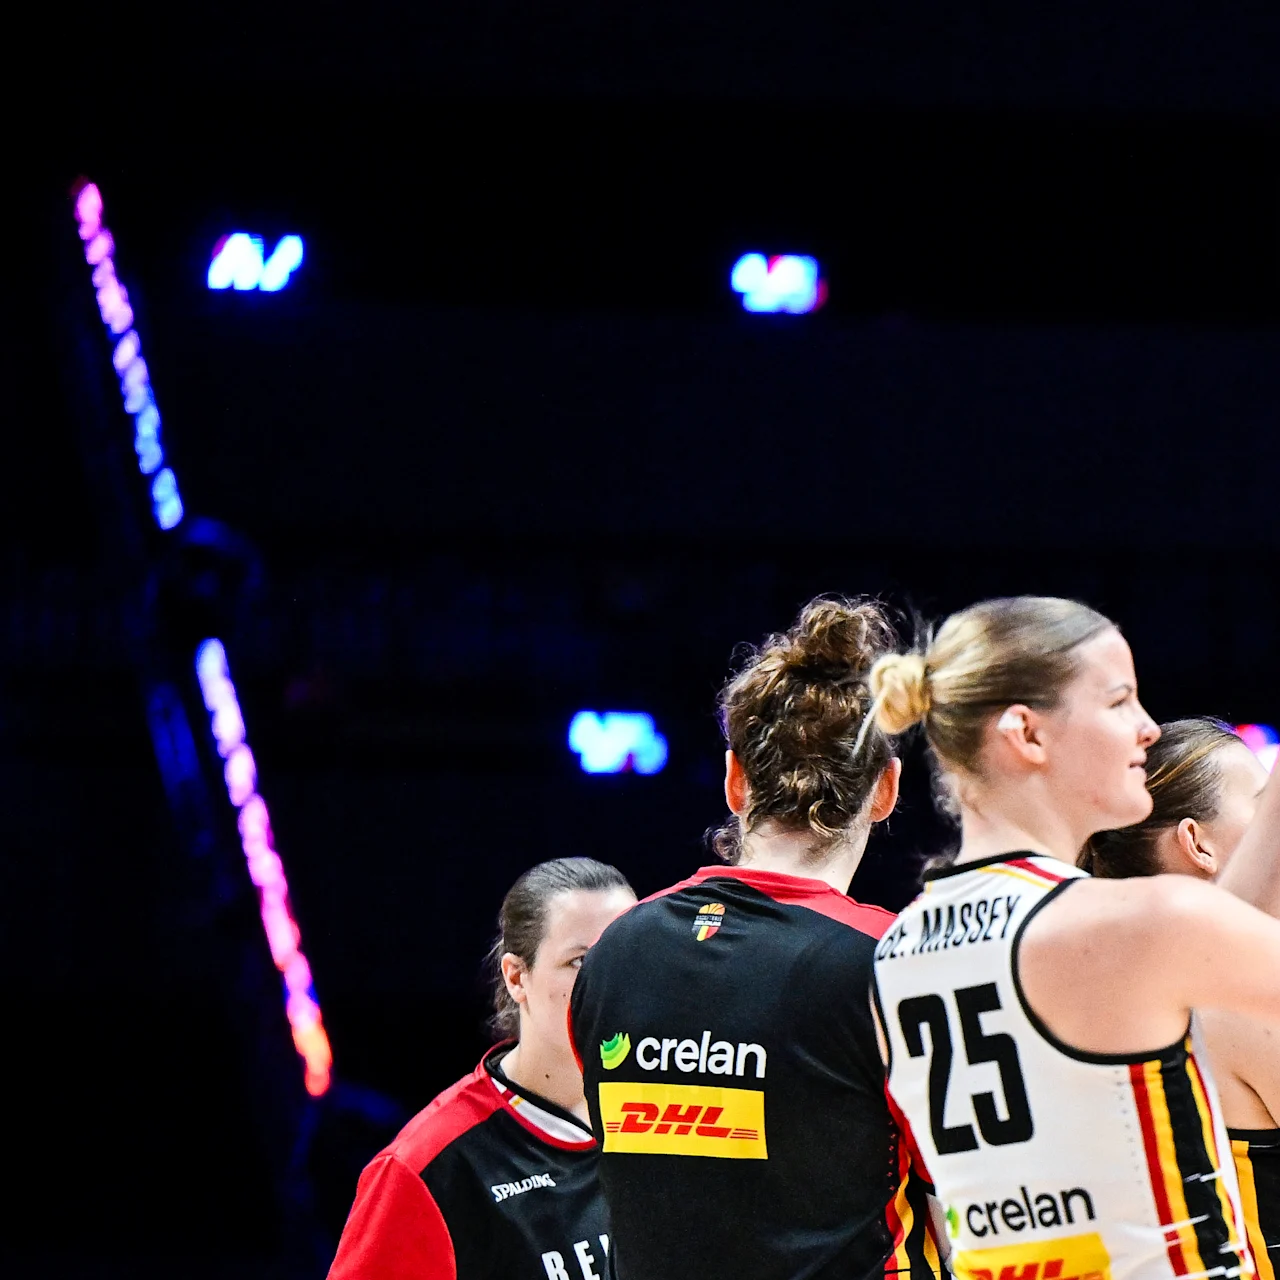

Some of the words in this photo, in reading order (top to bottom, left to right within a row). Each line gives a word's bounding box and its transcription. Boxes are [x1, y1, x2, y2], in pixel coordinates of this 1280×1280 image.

[912, 895, 1021, 954] MASSEY
[636, 1031, 767, 1078] crelan
[897, 981, 1034, 1156] 25
[620, 1102, 732, 1138] DHL
[491, 1173, 557, 1203] SPALDING
[966, 1185, 1096, 1237] crelan
